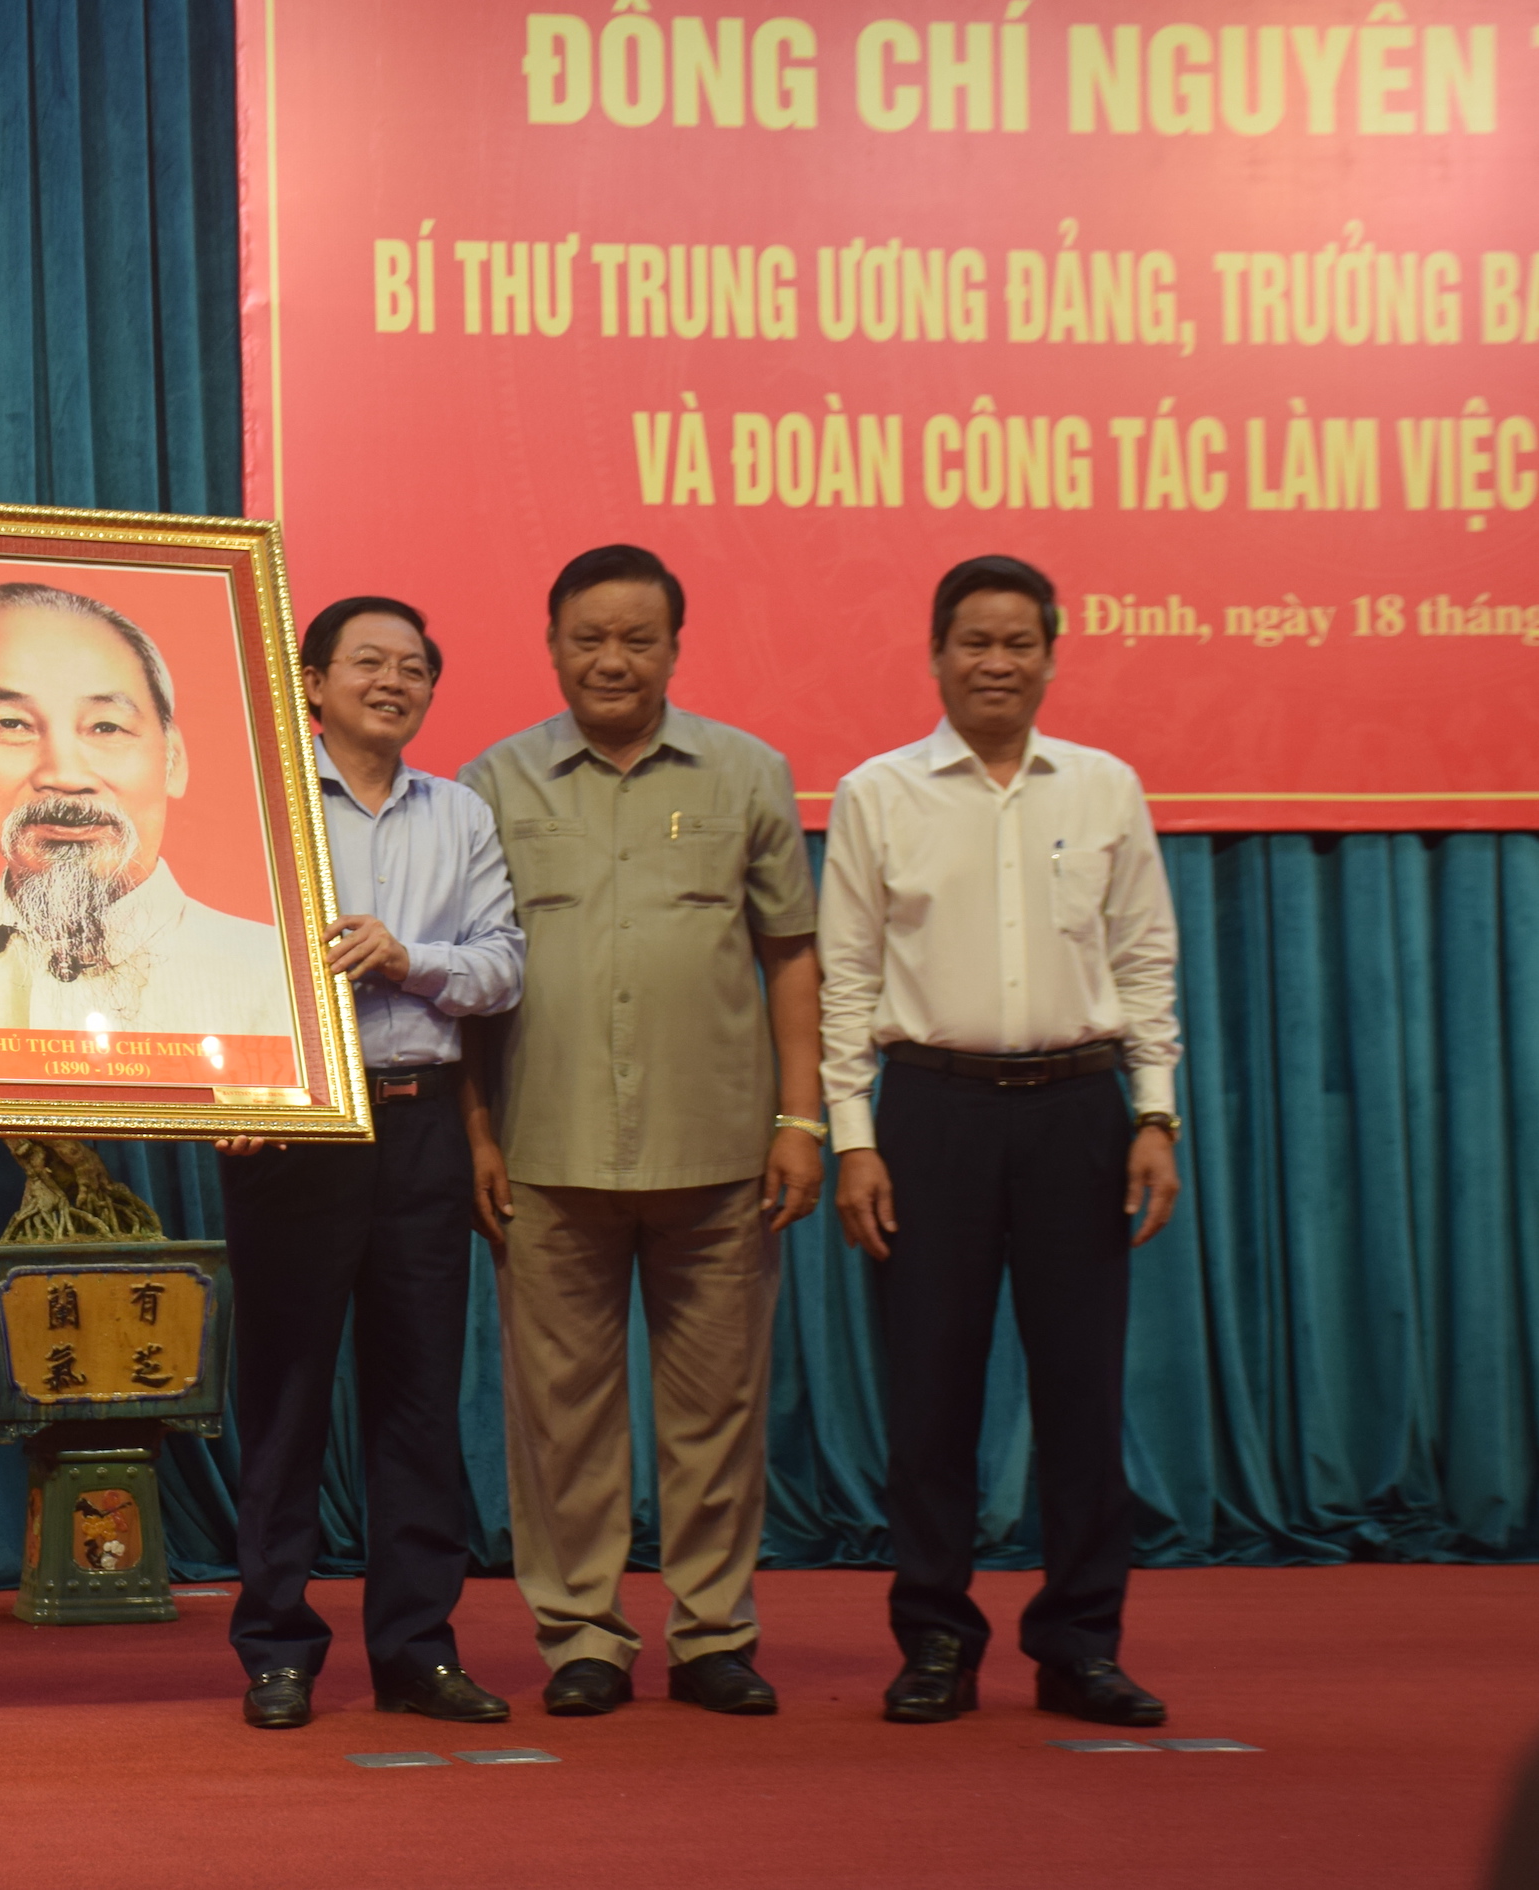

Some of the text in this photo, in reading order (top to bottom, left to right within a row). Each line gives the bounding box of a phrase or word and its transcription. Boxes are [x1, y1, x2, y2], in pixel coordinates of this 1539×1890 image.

[856, 0, 1032, 133] CHÍ
[374, 218, 436, 334] BÍ
[454, 232, 580, 337] THƯ
[591, 243, 798, 340] TRUNG
[817, 236, 988, 342] ƯƠNG
[1004, 217, 1196, 357] ĐẢNG,
[1213, 219, 1462, 346] TRƯỞNG
[632, 391, 1538, 532] VÀ ĐOÀN CÔNG TÁC LÀM VIỆC
[1080, 593, 1212, 648] Định,
[1223, 592, 1336, 647] ngày
[1352, 594, 1405, 636] 18
[26, 1038, 76, 1056] TỊCH
[115, 1038, 152, 1056] CHÍ
[44, 1059, 90, 1077] (1890
[107, 1062, 151, 1079] 1969)
